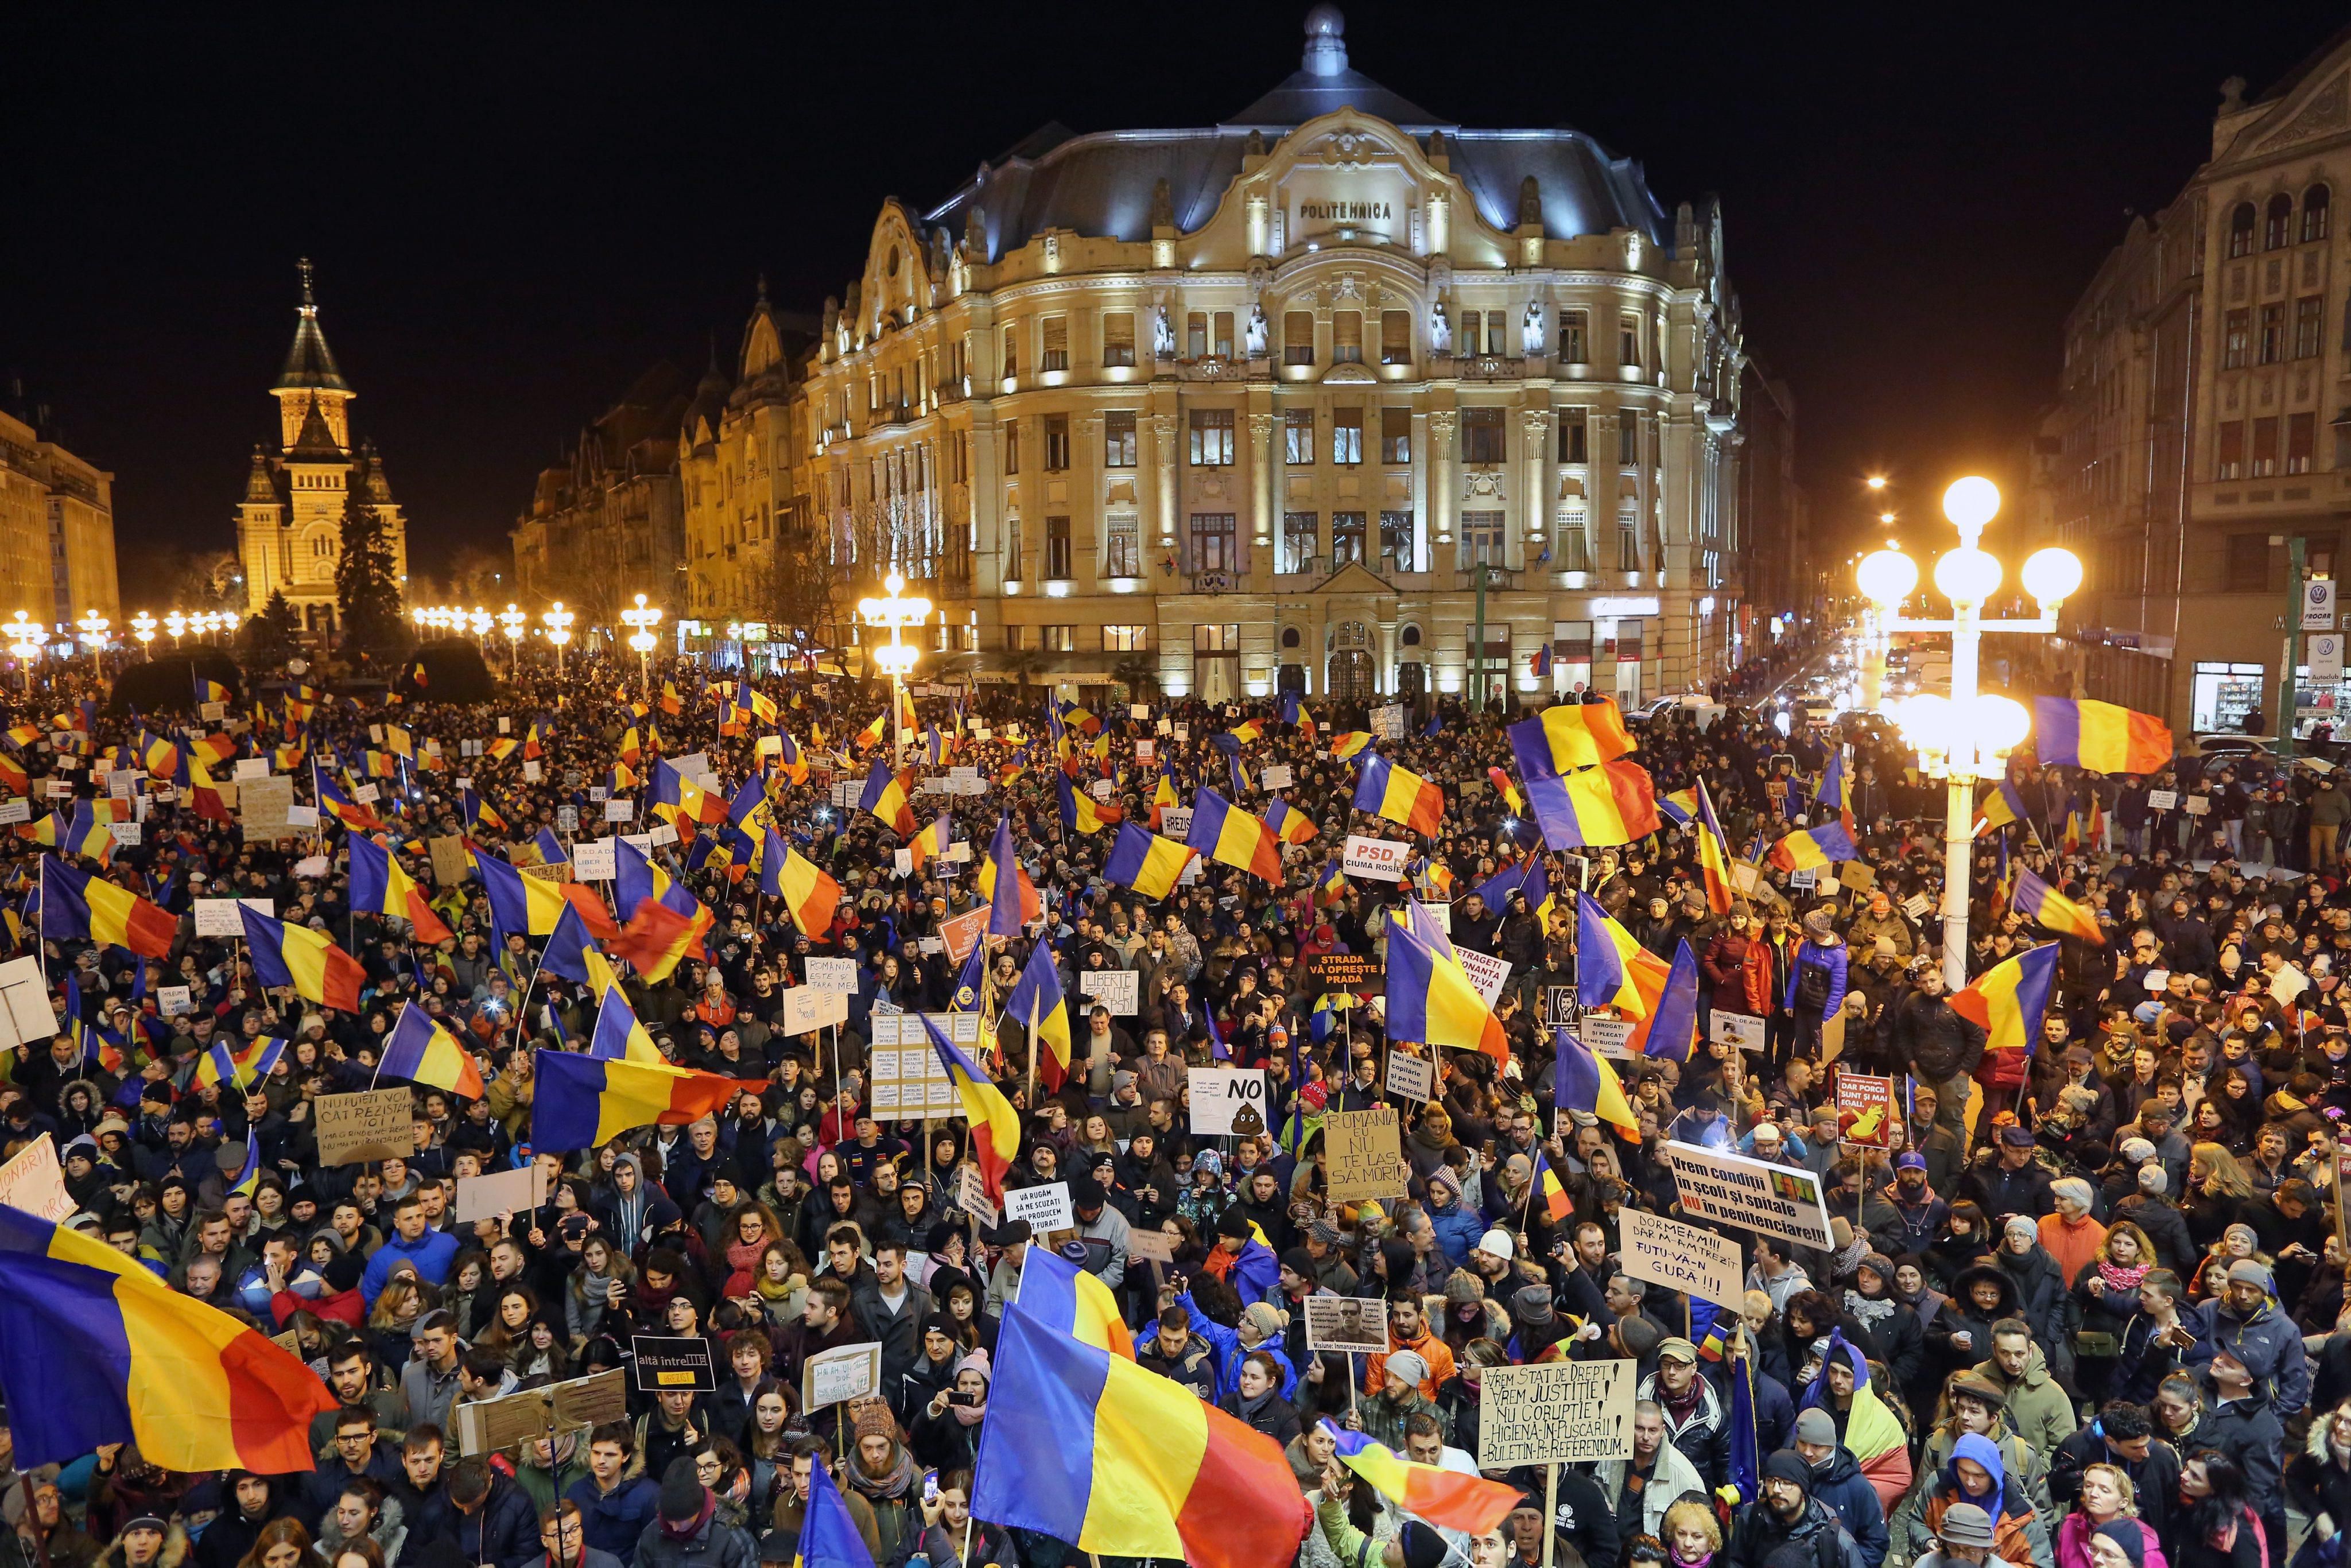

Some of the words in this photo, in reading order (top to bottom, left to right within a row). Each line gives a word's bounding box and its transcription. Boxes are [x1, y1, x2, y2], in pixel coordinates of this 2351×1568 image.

[1301, 201, 1391, 219] POLITEHNICA
[2116, 638, 2133, 646] citi
[1166, 816, 1193, 831] #REZIS
[1356, 844, 1394, 862] PSD
[557, 864, 565, 874] DE
[1345, 859, 1373, 870] CIUMA
[810, 961, 852, 971] ROMÂNIA
[1321, 956, 1364, 964] STRADA
[1310, 964, 1325, 974] VĂ
[1328, 965, 1378, 975] OPREȘTE
[1461, 960, 1499, 980] ONANȚA
[838, 981, 858, 990] MEA
[1086, 971, 1132, 987] LIBERTÉ
[1110, 995, 1133, 1014] PSD!
[1593, 1022, 1623, 1030] ABROGAȚI
[1393, 1054, 1405, 1062] Noi
[1405, 1058, 1423, 1068] vrem
[1392, 1064, 1421, 1077] copilărie
[1390, 1072, 1398, 1081] și
[1398, 1075, 1407, 1084] pe
[1408, 1076, 1422, 1088] hoți
[1228, 1079, 1262, 1099] NO
[1397, 1084, 1427, 1099] pușcărie
[1841, 1091, 1861, 1099] SUNT
[1863, 1093, 1871, 1101] ȘI
[1860, 1085, 1886, 1093] PORCII
[324, 1097, 343, 1109] NU
[385, 1090, 409, 1102] VOI
[1841, 1100, 1865, 1108] EGALI.
[322, 1108, 349, 1123] CAT
[1326, 1111, 1399, 1130] ROMÂNIA
[1353, 1128, 1369, 1137] EU
[1349, 1137, 1375, 1154] NU
[1340, 1155, 1360, 1167] TE
[1368, 1152, 1398, 1165] LAS
[968, 1173, 978, 1183] VREM
[1362, 1166, 1402, 1184] MORI!
[1671, 1154, 1708, 1176] Vrem
[1709, 1165, 1767, 1192] condiții
[1019, 1192, 1029, 1201] VĂ
[1030, 1189, 1052, 1200] RUGĂM
[1678, 1174, 1695, 1191] în
[1697, 1179, 1733, 1203] școli
[1734, 1189, 1744, 1205] și
[1747, 1194, 1797, 1218] spitale
[976, 1197, 988, 1209] PENALI
[1016, 1202, 1025, 1212] SĂ
[1026, 1203, 1034, 1211] NE
[1035, 1198, 1061, 1210] SCUZAȚI
[969, 1201, 992, 1222] CONDAMNARE
[1029, 1209, 1062, 1221] PRODUCEM
[1037, 1218, 1060, 1231] FURAȚI
[1682, 1195, 1702, 1211] NU
[1703, 1200, 1718, 1214] în
[1720, 1206, 1829, 1245] penitenciare!!!
[1634, 1226, 1655, 1240] DAR
[1658, 1234, 1697, 1253] M-AM
[1640, 1215, 1721, 1253] DORMEAM!!!
[1636, 1241, 1706, 1271] FUTU-VĂ-N
[1651, 1261, 1698, 1284] GURĂ
[639, 1355, 658, 1365] altă
[661, 1354, 687, 1367] între
[1519, 1365, 1553, 1385] STAT
[1556, 1371, 1567, 1381] DE
[1570, 1364, 1608, 1382] DREPT
[1529, 1379, 1599, 1404] JUSTIȚIE
[1497, 1406, 1516, 1425] NU
[1521, 1402, 1591, 1425] CORUPȚIE
